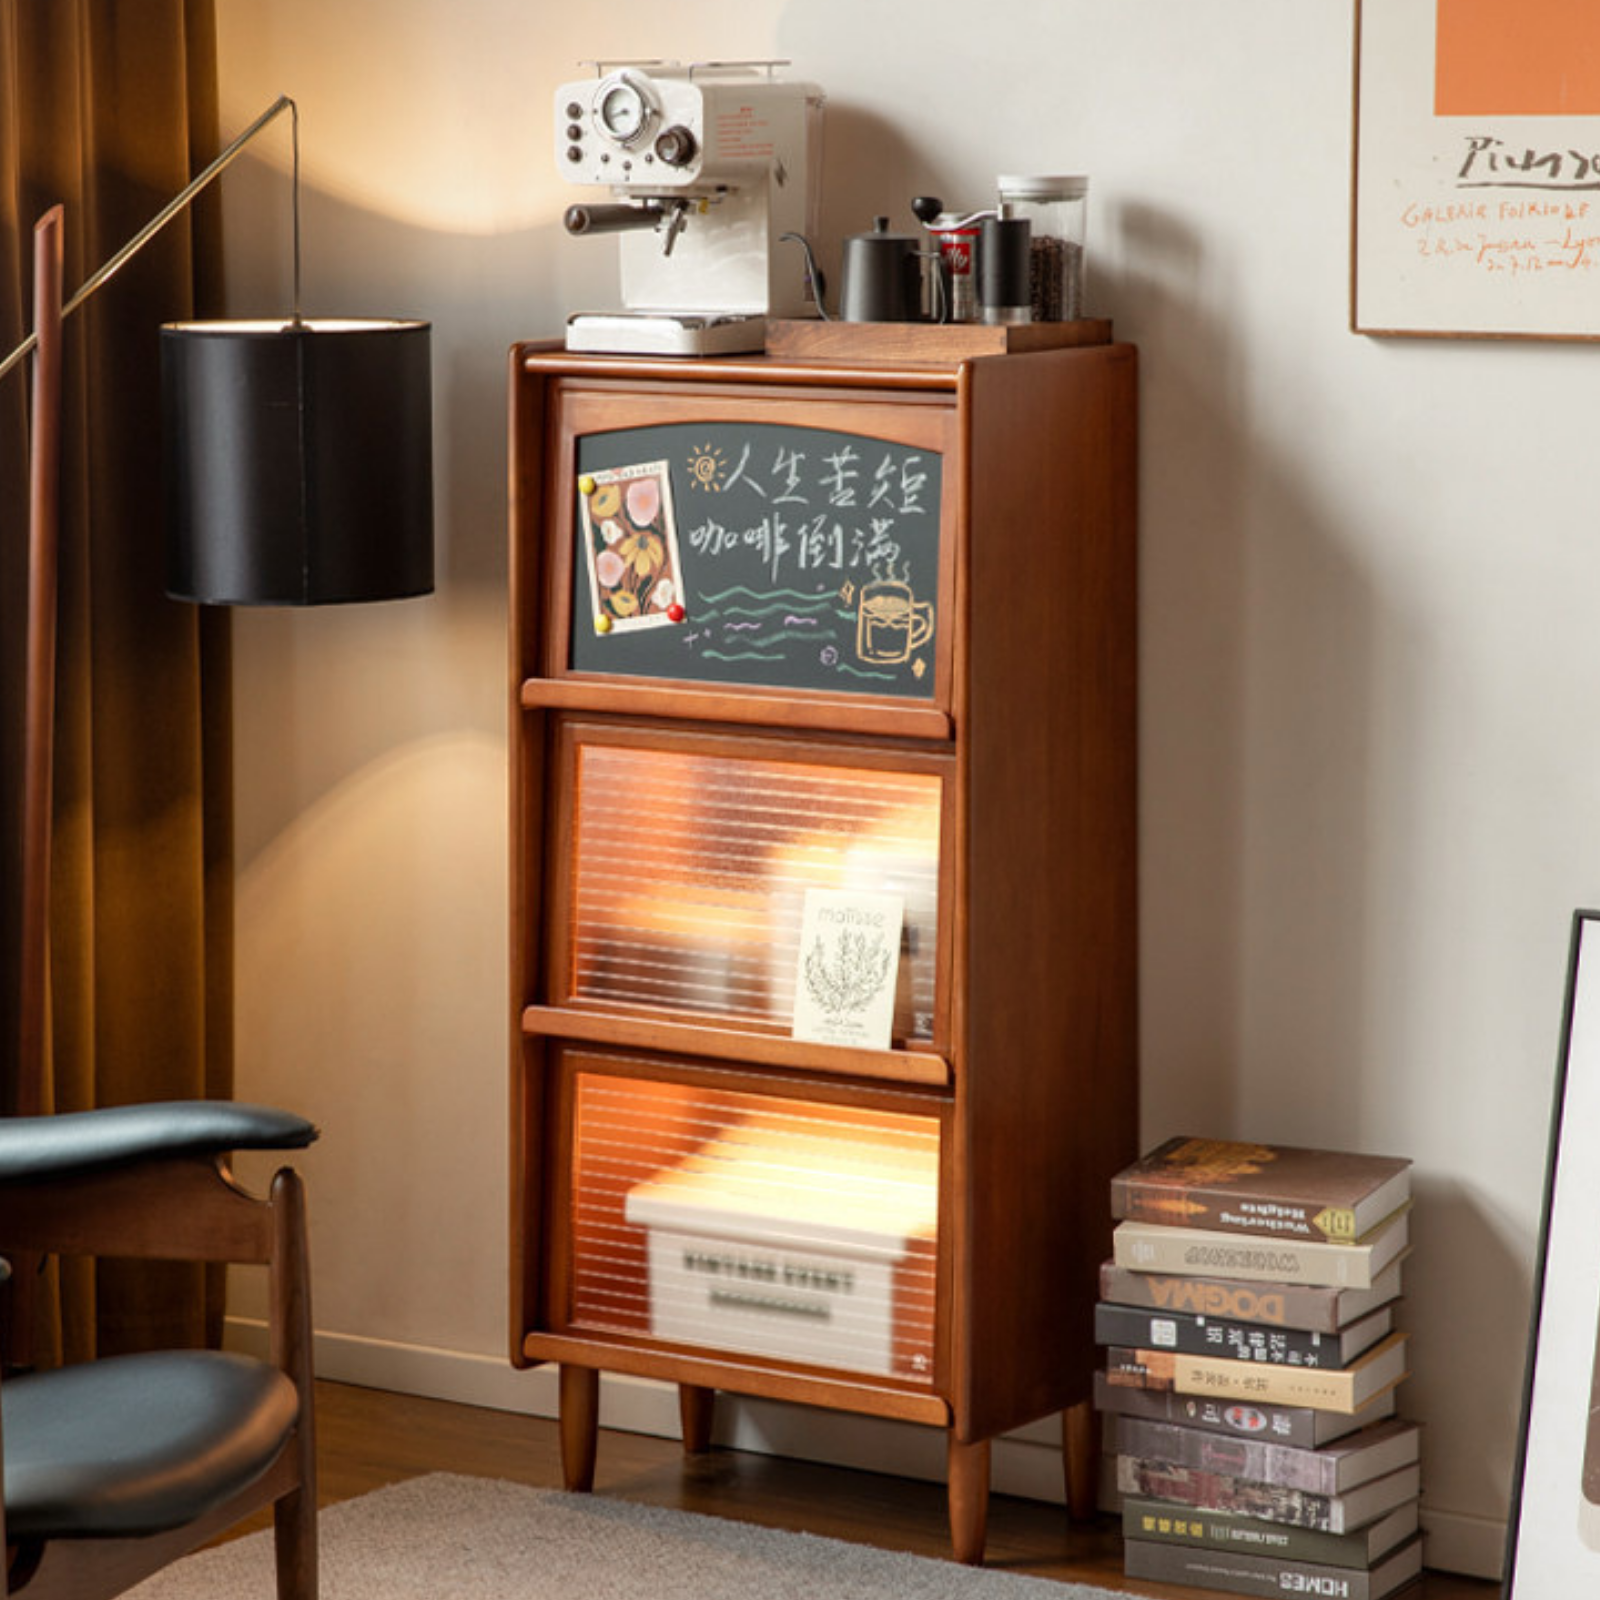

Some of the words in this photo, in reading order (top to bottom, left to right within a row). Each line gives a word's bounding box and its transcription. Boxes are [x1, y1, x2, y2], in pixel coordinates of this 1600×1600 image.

[722, 443, 929, 515] 人生苦短
[689, 512, 900, 583] 咖啡倒满
[1147, 1277, 1285, 1324] DOGMA
[1279, 1572, 1348, 1598] HOMES
